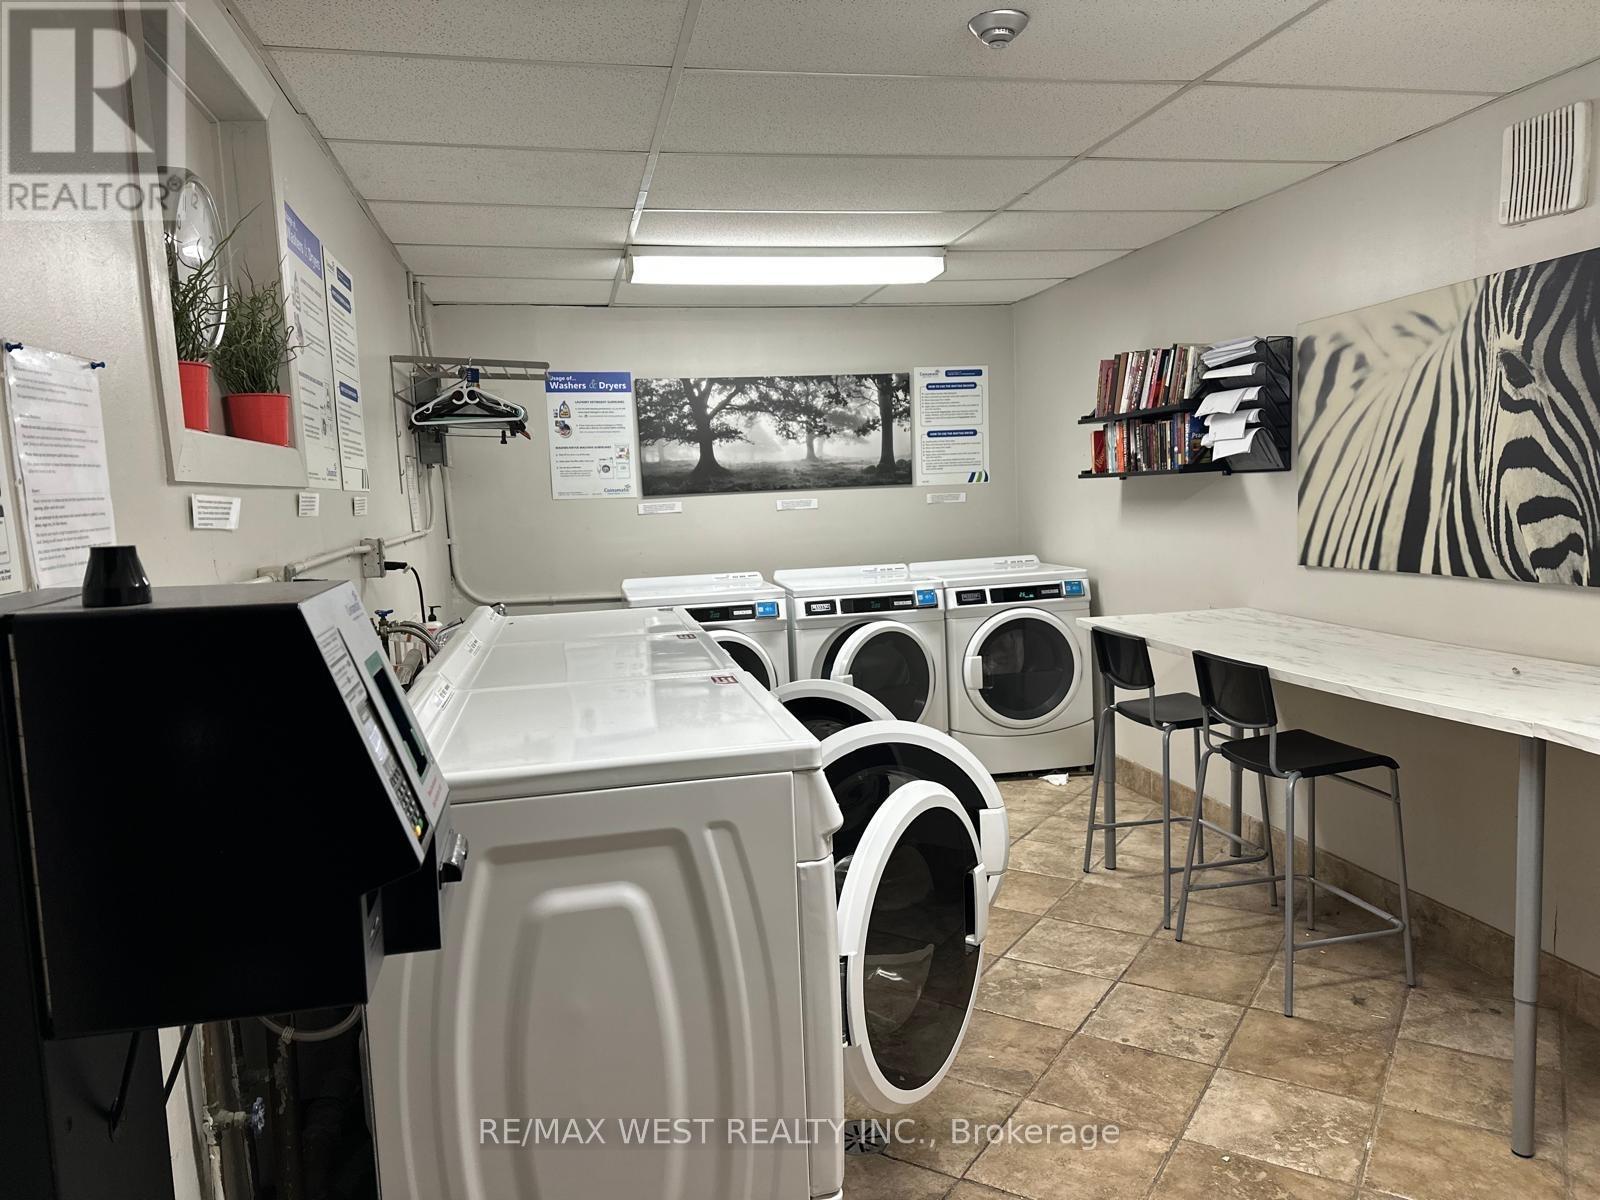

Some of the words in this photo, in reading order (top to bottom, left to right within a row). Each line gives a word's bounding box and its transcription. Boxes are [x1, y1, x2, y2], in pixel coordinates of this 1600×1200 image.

[549, 381, 587, 390] Washers
[588, 379, 598, 390] &
[598, 381, 627, 391] Dryers
